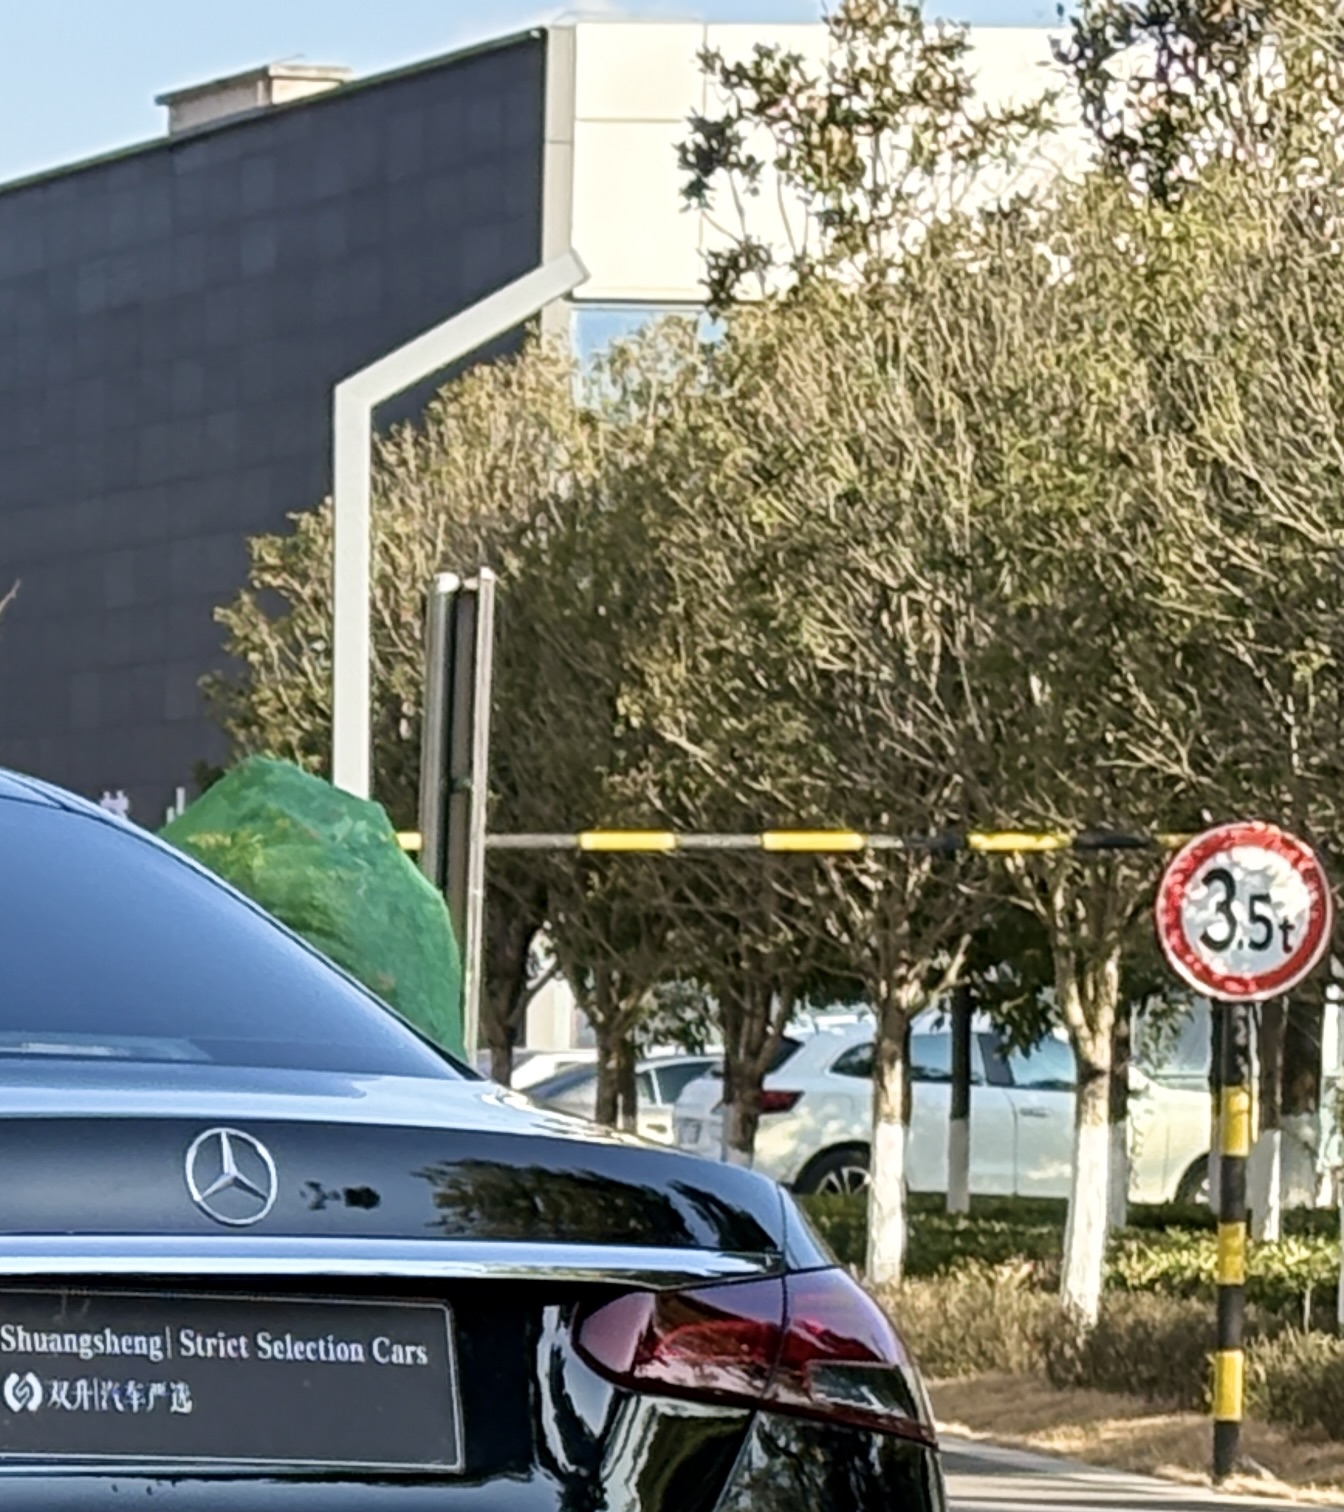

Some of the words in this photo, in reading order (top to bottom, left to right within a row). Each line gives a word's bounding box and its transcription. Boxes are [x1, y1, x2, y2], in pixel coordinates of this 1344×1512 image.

[180, 1328, 250, 1359] Strict
[256, 1331, 366, 1362] Selection
[372, 1336, 429, 1365] Cars
